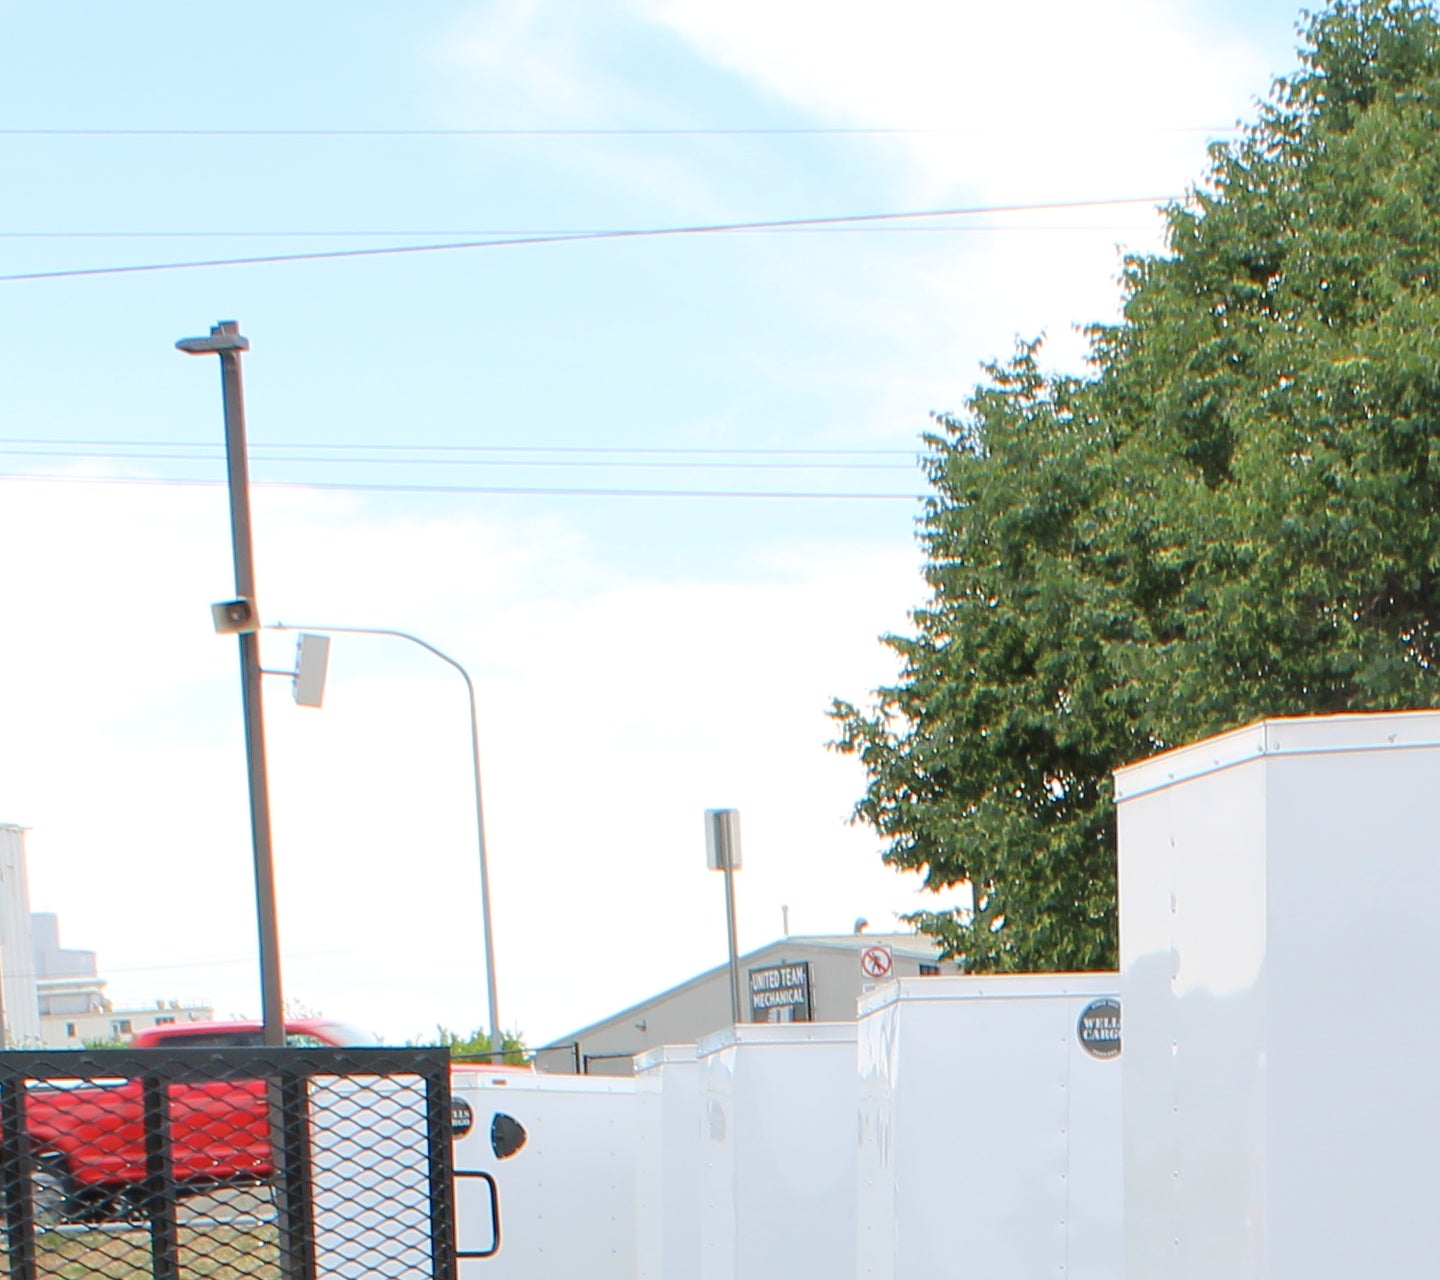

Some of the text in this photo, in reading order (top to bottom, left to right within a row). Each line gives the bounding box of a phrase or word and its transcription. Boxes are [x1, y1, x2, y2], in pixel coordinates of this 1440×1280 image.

[752, 965, 804, 991] UNITED TEAM
[753, 988, 804, 1008] MECHANICAL
[1083, 1017, 1120, 1029] WELL
[1083, 1028, 1120, 1040] CARG
